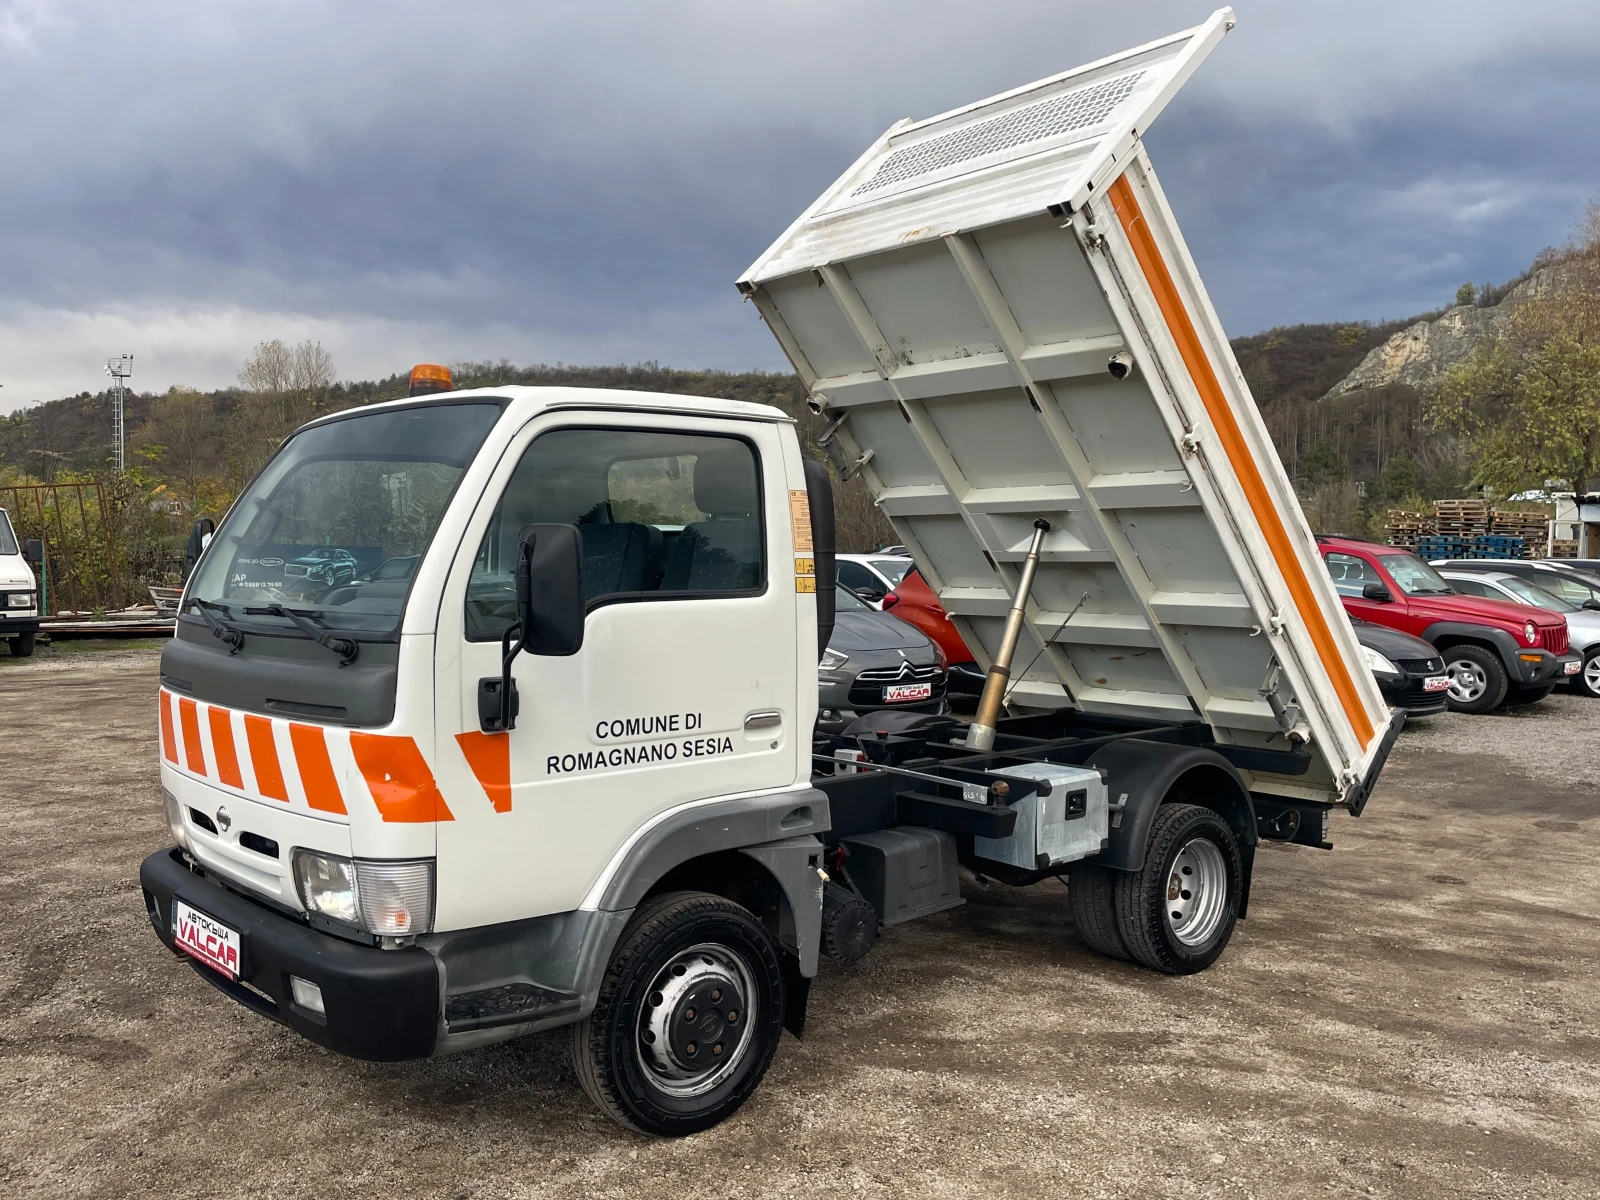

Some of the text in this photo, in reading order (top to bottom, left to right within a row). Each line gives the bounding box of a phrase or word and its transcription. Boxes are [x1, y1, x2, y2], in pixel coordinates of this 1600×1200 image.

[889, 688, 930, 699] VALCAR
[595, 712, 702, 739] COMUNE DI
[546, 736, 734, 775] ROMAGNANO SESIA
[179, 917, 237, 972] VALCAR
